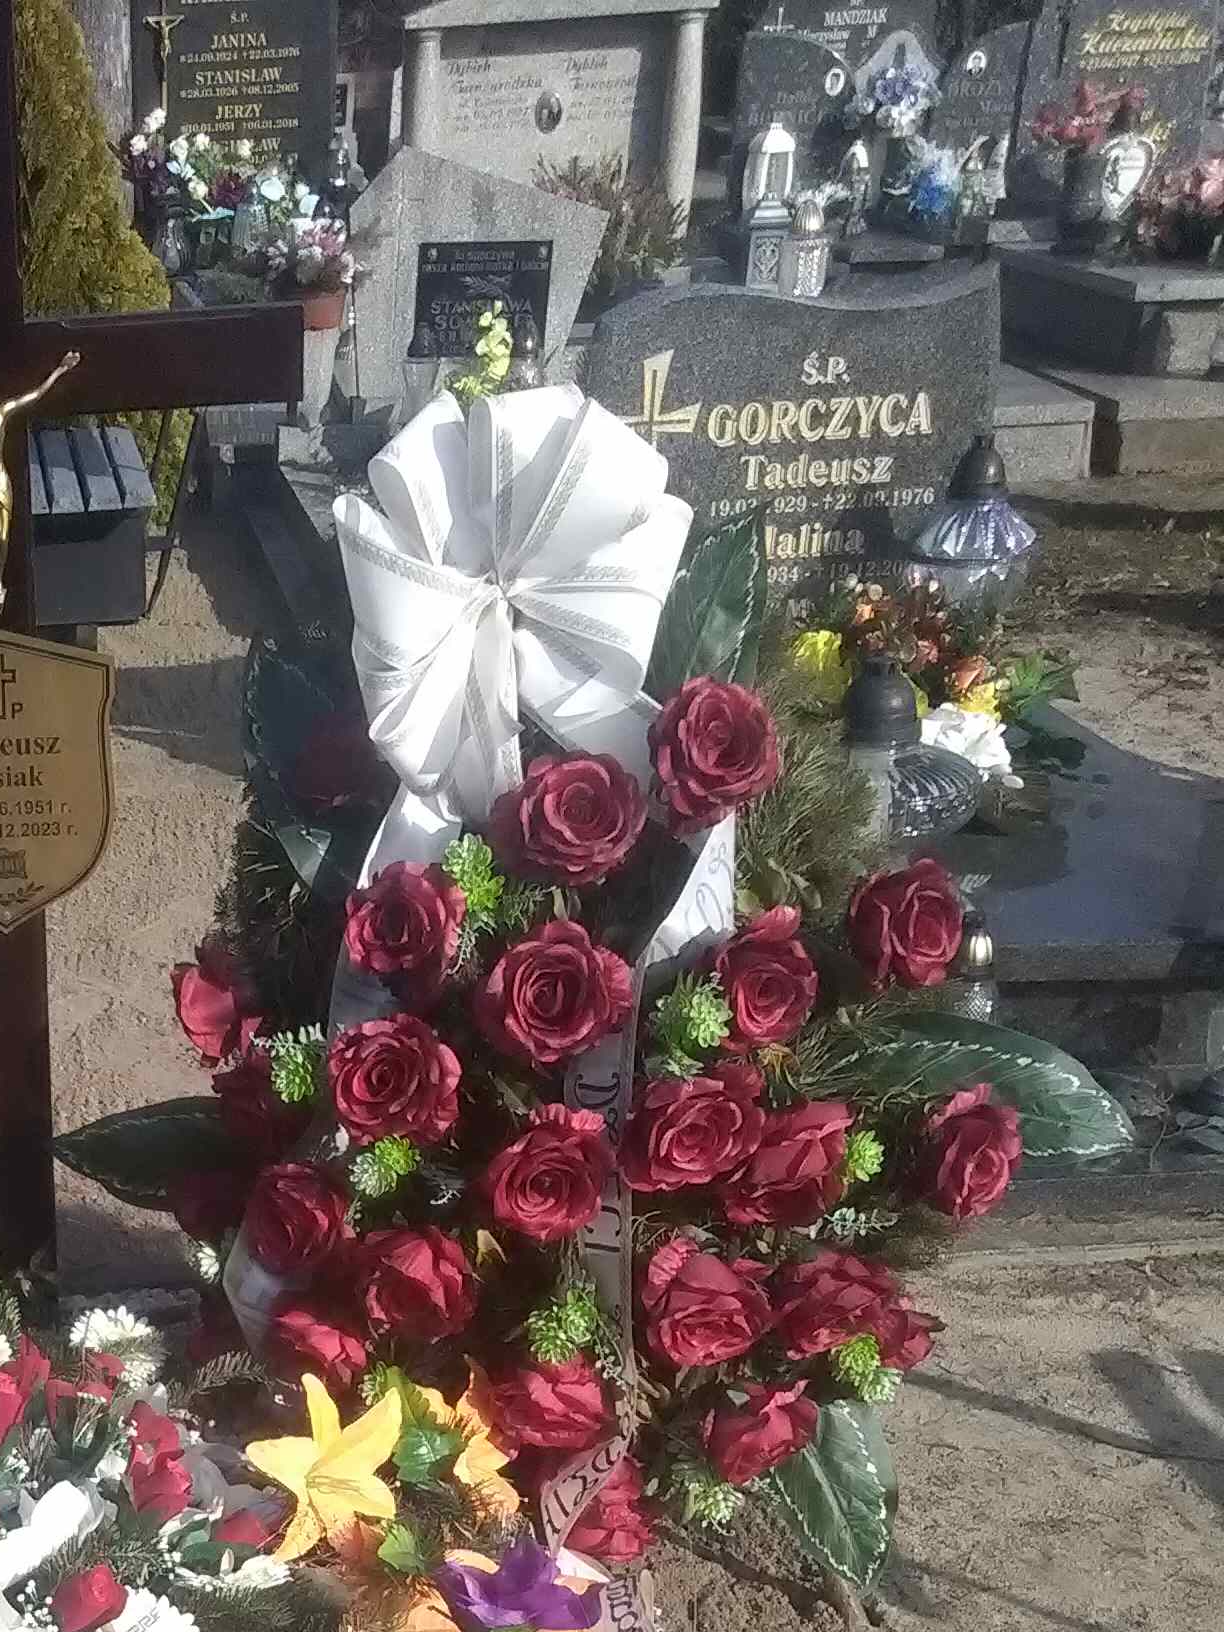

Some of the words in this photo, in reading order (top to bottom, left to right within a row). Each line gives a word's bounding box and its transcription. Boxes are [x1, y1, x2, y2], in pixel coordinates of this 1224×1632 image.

[210, 32, 268, 50] JANINA
[215, 103, 263, 121] JERZY
[801, 351, 851, 386] Ś.P.
[707, 391, 935, 448] GORCZYCA
[740, 453, 895, 491] Tadeusz
[11, 702, 24, 719] P
[60, 801, 72, 814] r.
[66, 823, 79, 837] r.
